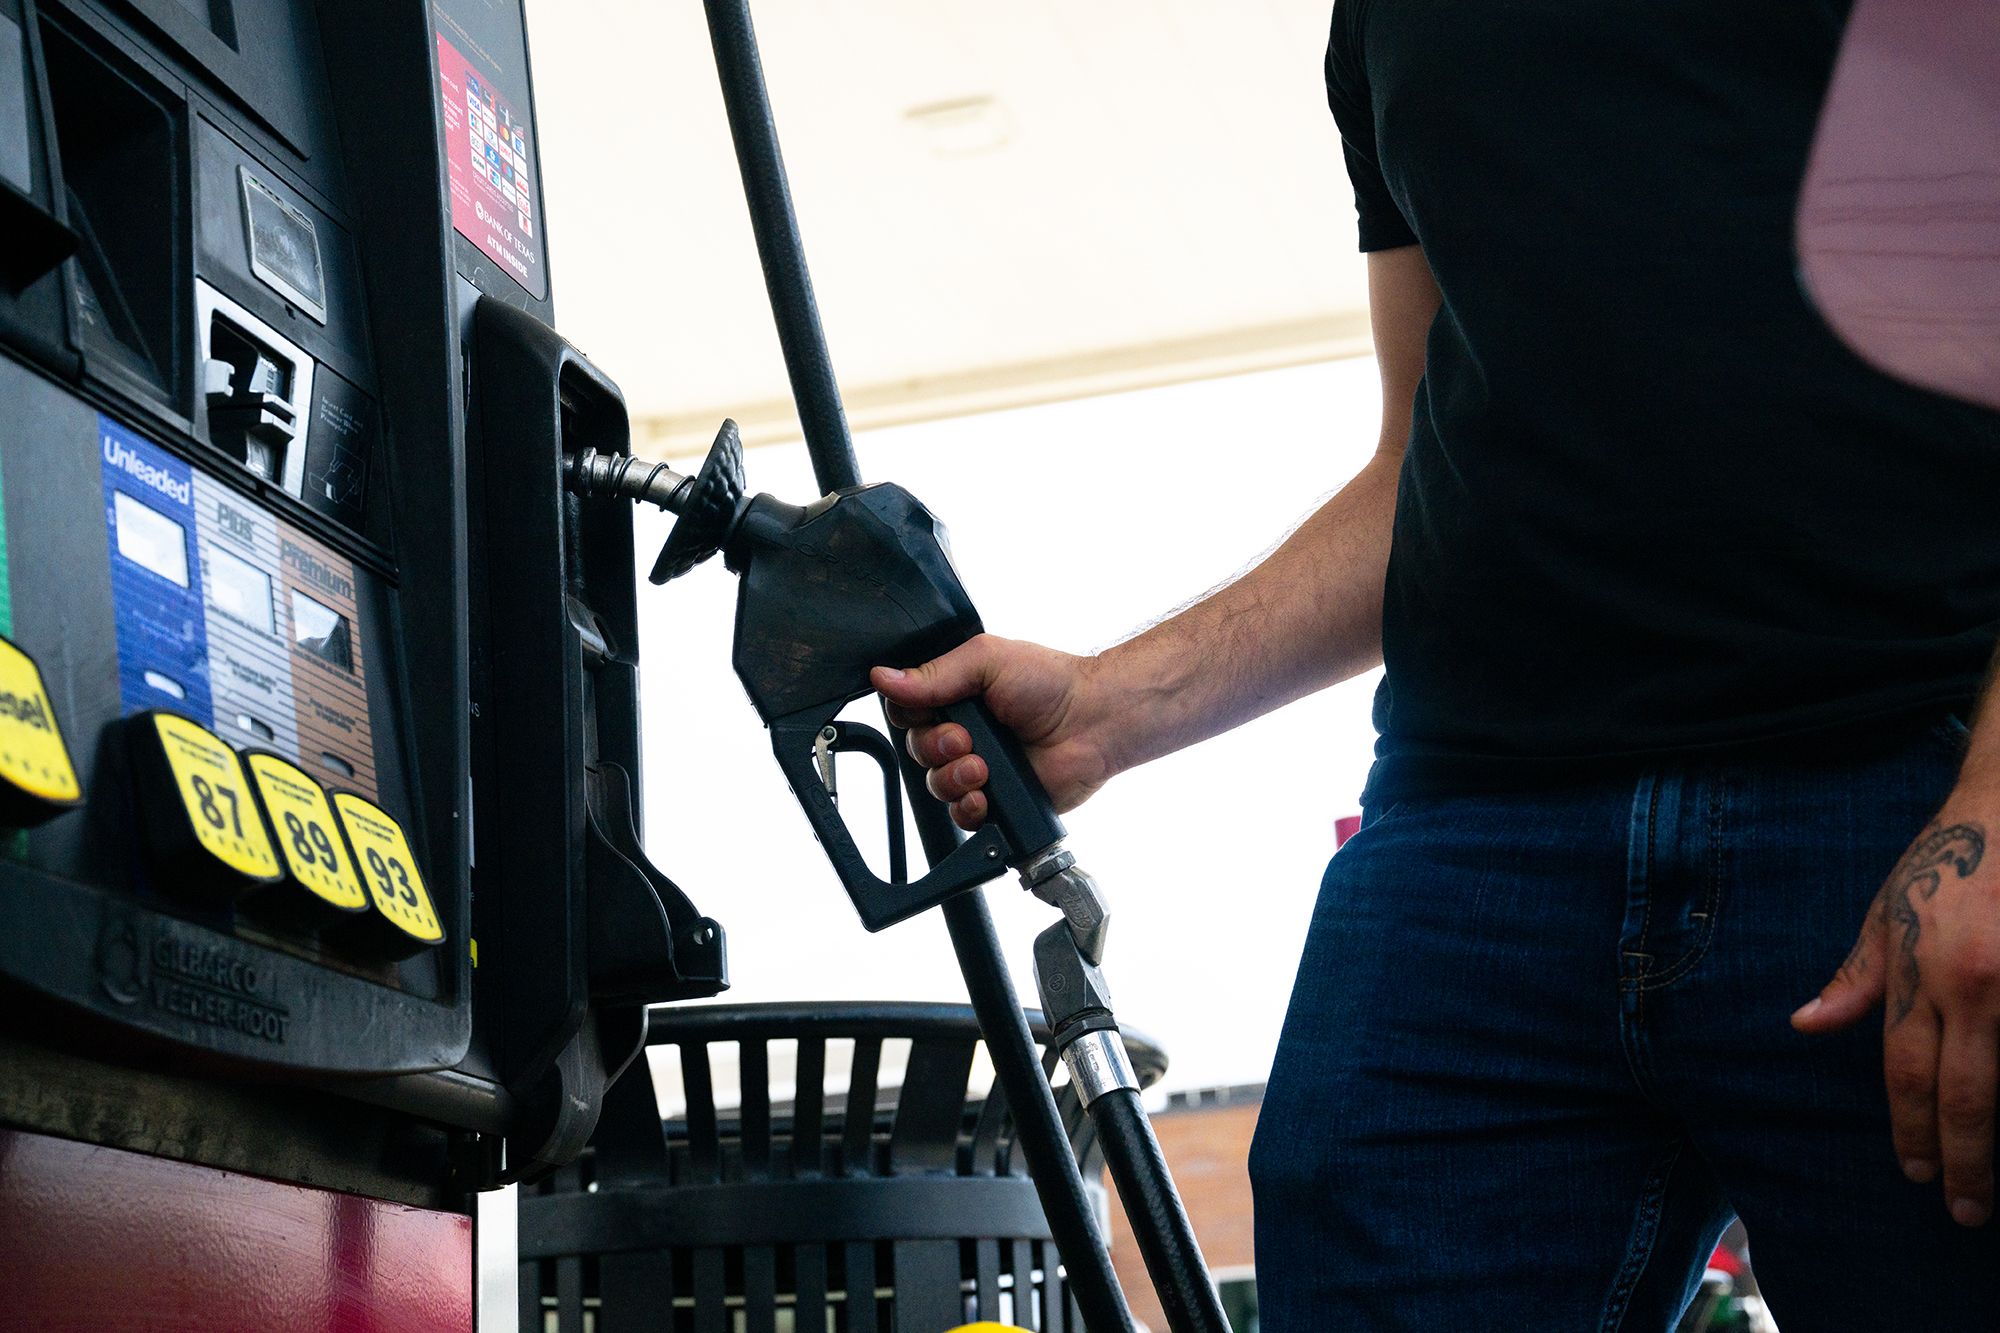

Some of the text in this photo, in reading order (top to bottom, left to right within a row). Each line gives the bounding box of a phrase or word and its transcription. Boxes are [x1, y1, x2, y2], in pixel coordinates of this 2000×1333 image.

[484, 210, 536, 264] BANK OF TEXAS
[486, 234, 529, 278] ATM INSIDE
[104, 436, 190, 505] Unleaded
[281, 538, 352, 600] Premium
[191, 774, 244, 839] 87
[284, 811, 339, 874] 89
[366, 847, 418, 908] 93
[151, 936, 258, 994] GILBARCO
[151, 980, 290, 1044] VEEDER-ROOT
